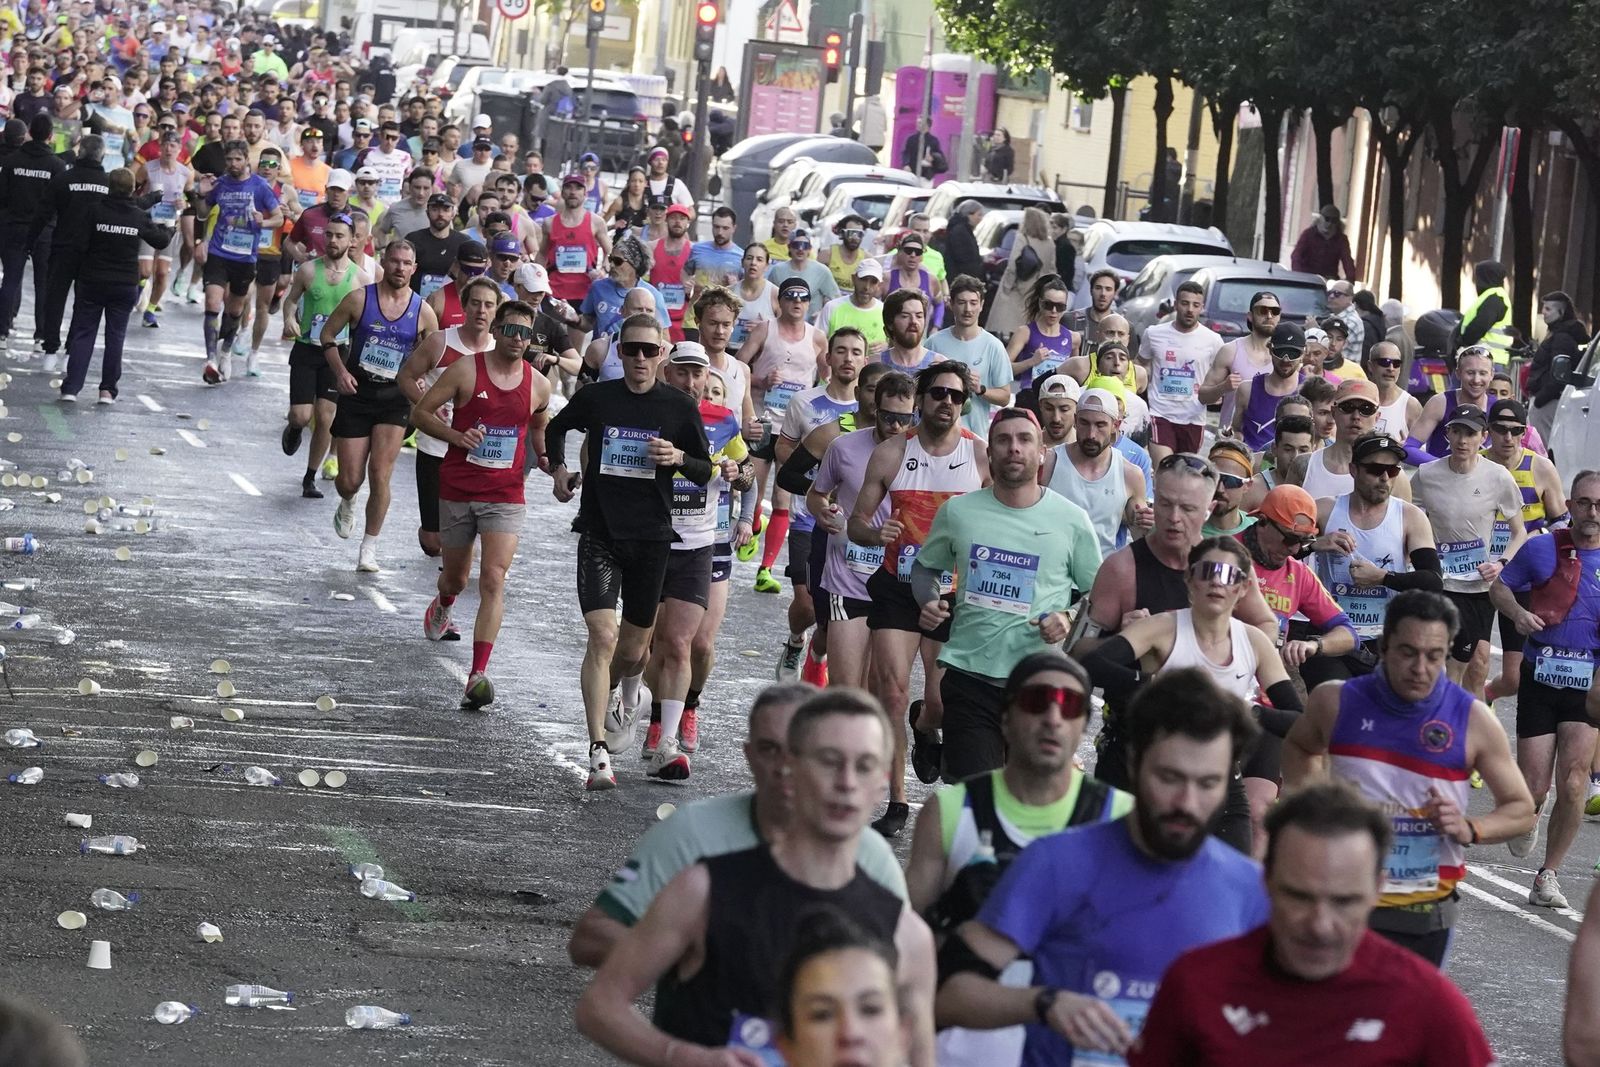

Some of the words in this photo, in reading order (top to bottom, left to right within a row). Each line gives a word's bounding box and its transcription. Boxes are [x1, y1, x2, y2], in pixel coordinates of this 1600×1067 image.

[13, 167, 51, 180] VOLUNTEER
[68, 183, 109, 195] VOLUNTEER
[96, 223, 139, 236] VOLUNTEER
[364, 353, 395, 369] ARNAUD
[1164, 386, 1188, 394] TORRES
[488, 428, 514, 436] ZURICH
[622, 430, 653, 440] ZURICH
[482, 448, 502, 459] LUIS
[621, 445, 638, 453] 9032
[610, 453, 647, 467] PIERRE
[673, 494, 690, 502] 5160
[1452, 540, 1480, 551] ZURICH
[993, 552, 1031, 566] ZURICH
[991, 569, 1012, 581] 7364
[977, 580, 1021, 599] JULIEN
[1350, 587, 1382, 596] ZURICH
[1350, 602, 1367, 611] 6615
[1347, 612, 1380, 624] RMAN
[1556, 649, 1588, 659] ZURICH
[1555, 664, 1573, 673] 8583
[1537, 672, 1589, 688] RAYMOND
